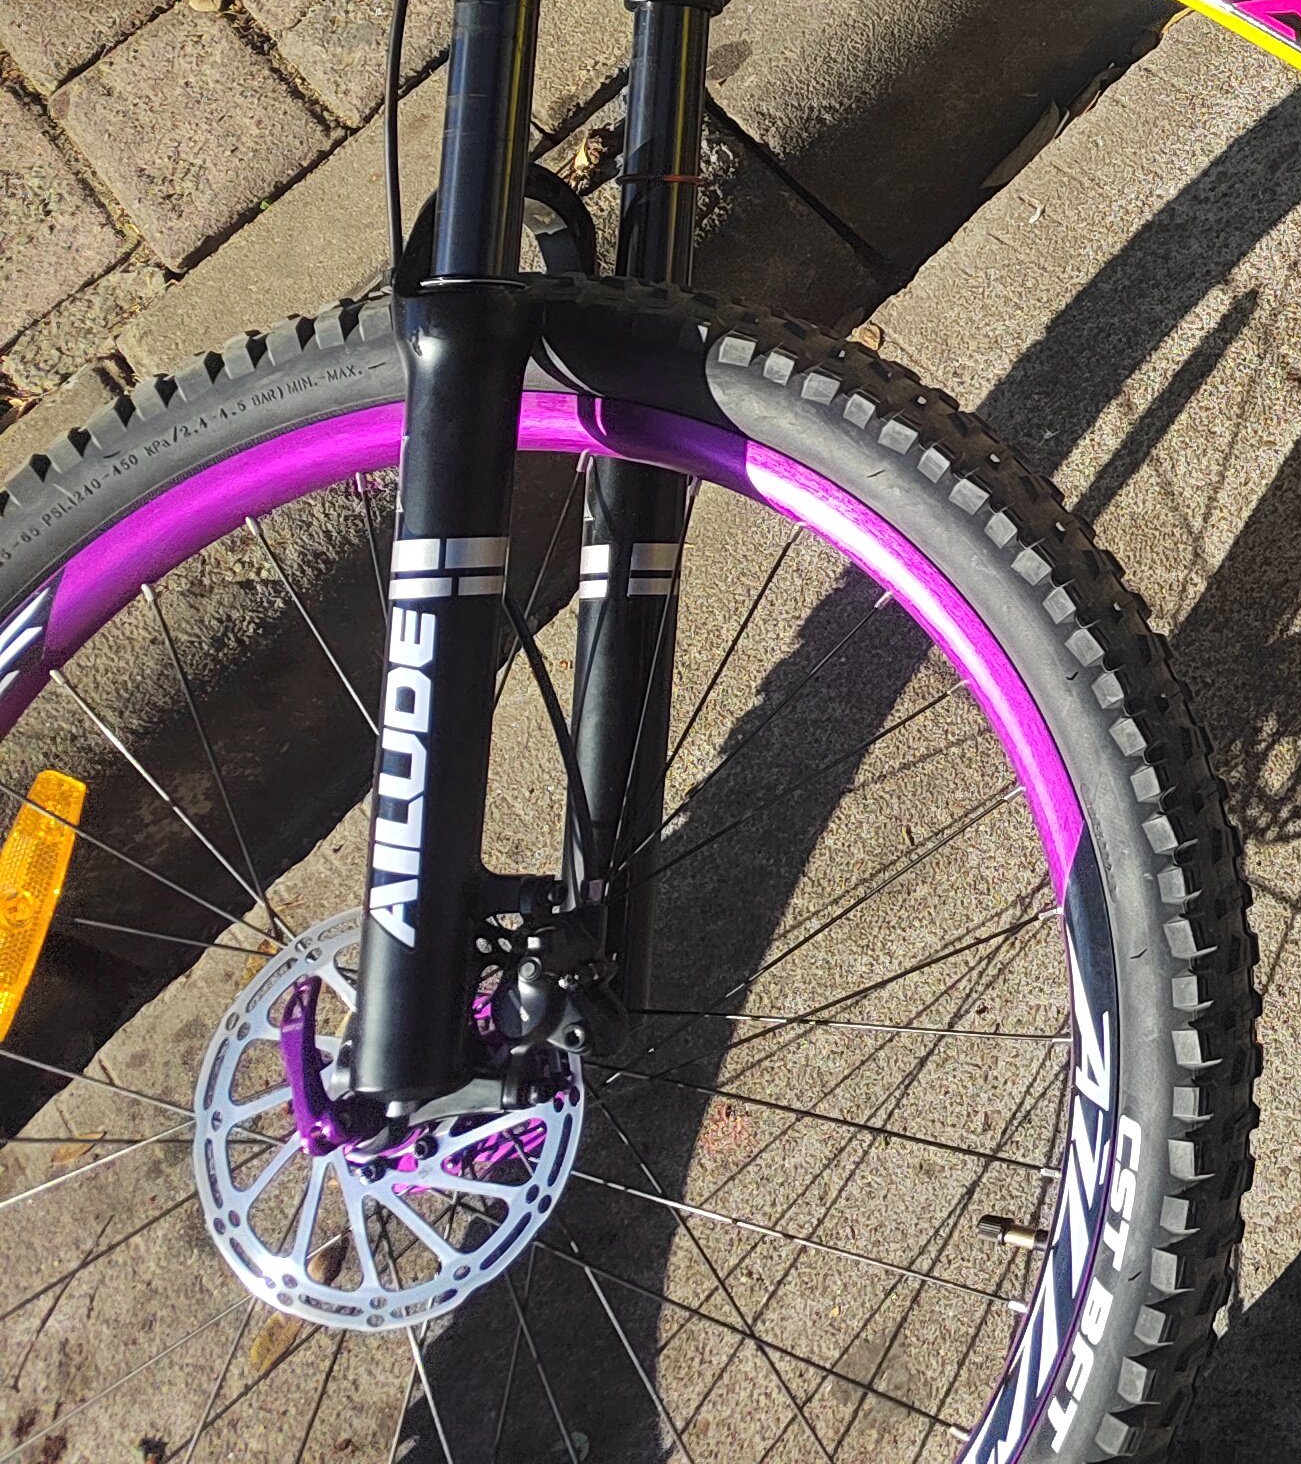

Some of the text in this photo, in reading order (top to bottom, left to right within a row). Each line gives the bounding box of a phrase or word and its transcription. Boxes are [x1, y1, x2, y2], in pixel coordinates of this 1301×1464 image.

[369, 606, 437, 949] AILUDE
[1050, 1115, 1142, 1454] CST BFT
